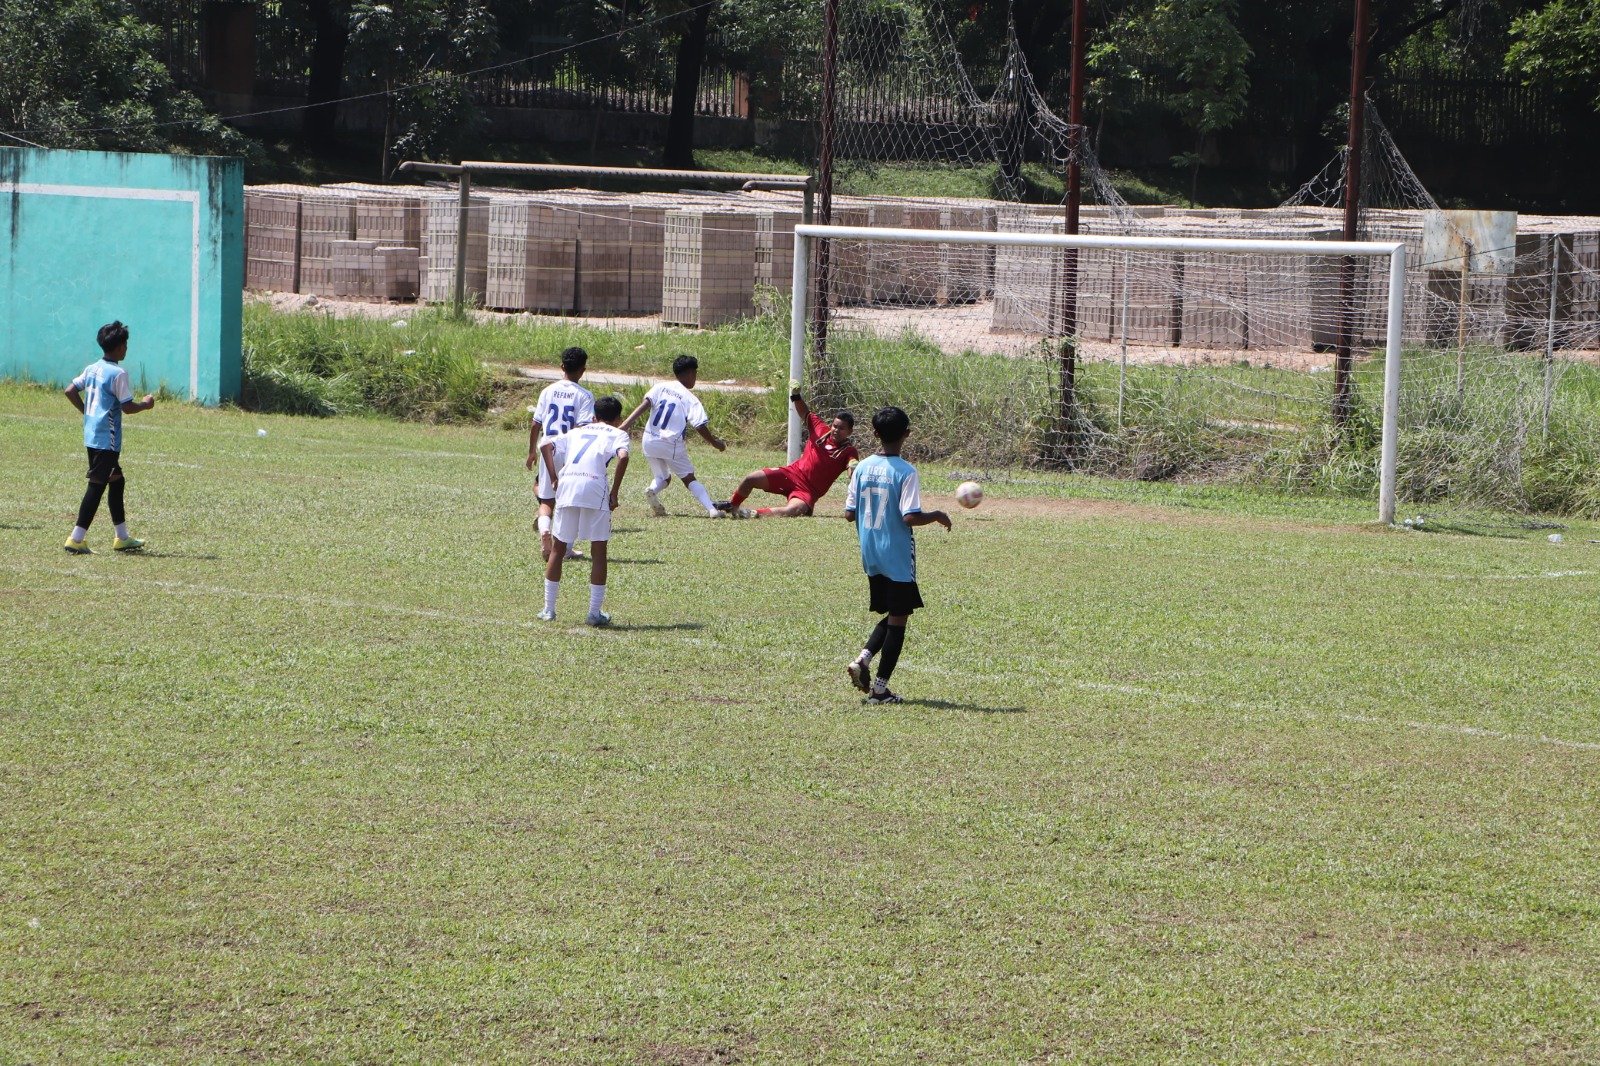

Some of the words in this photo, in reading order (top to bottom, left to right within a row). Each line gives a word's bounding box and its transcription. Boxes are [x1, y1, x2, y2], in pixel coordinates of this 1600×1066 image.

[545, 403, 575, 436] 25
[652, 399, 676, 430] 11
[572, 433, 598, 465] 7
[866, 465, 887, 476] TIRTA
[860, 486, 889, 530] 17
